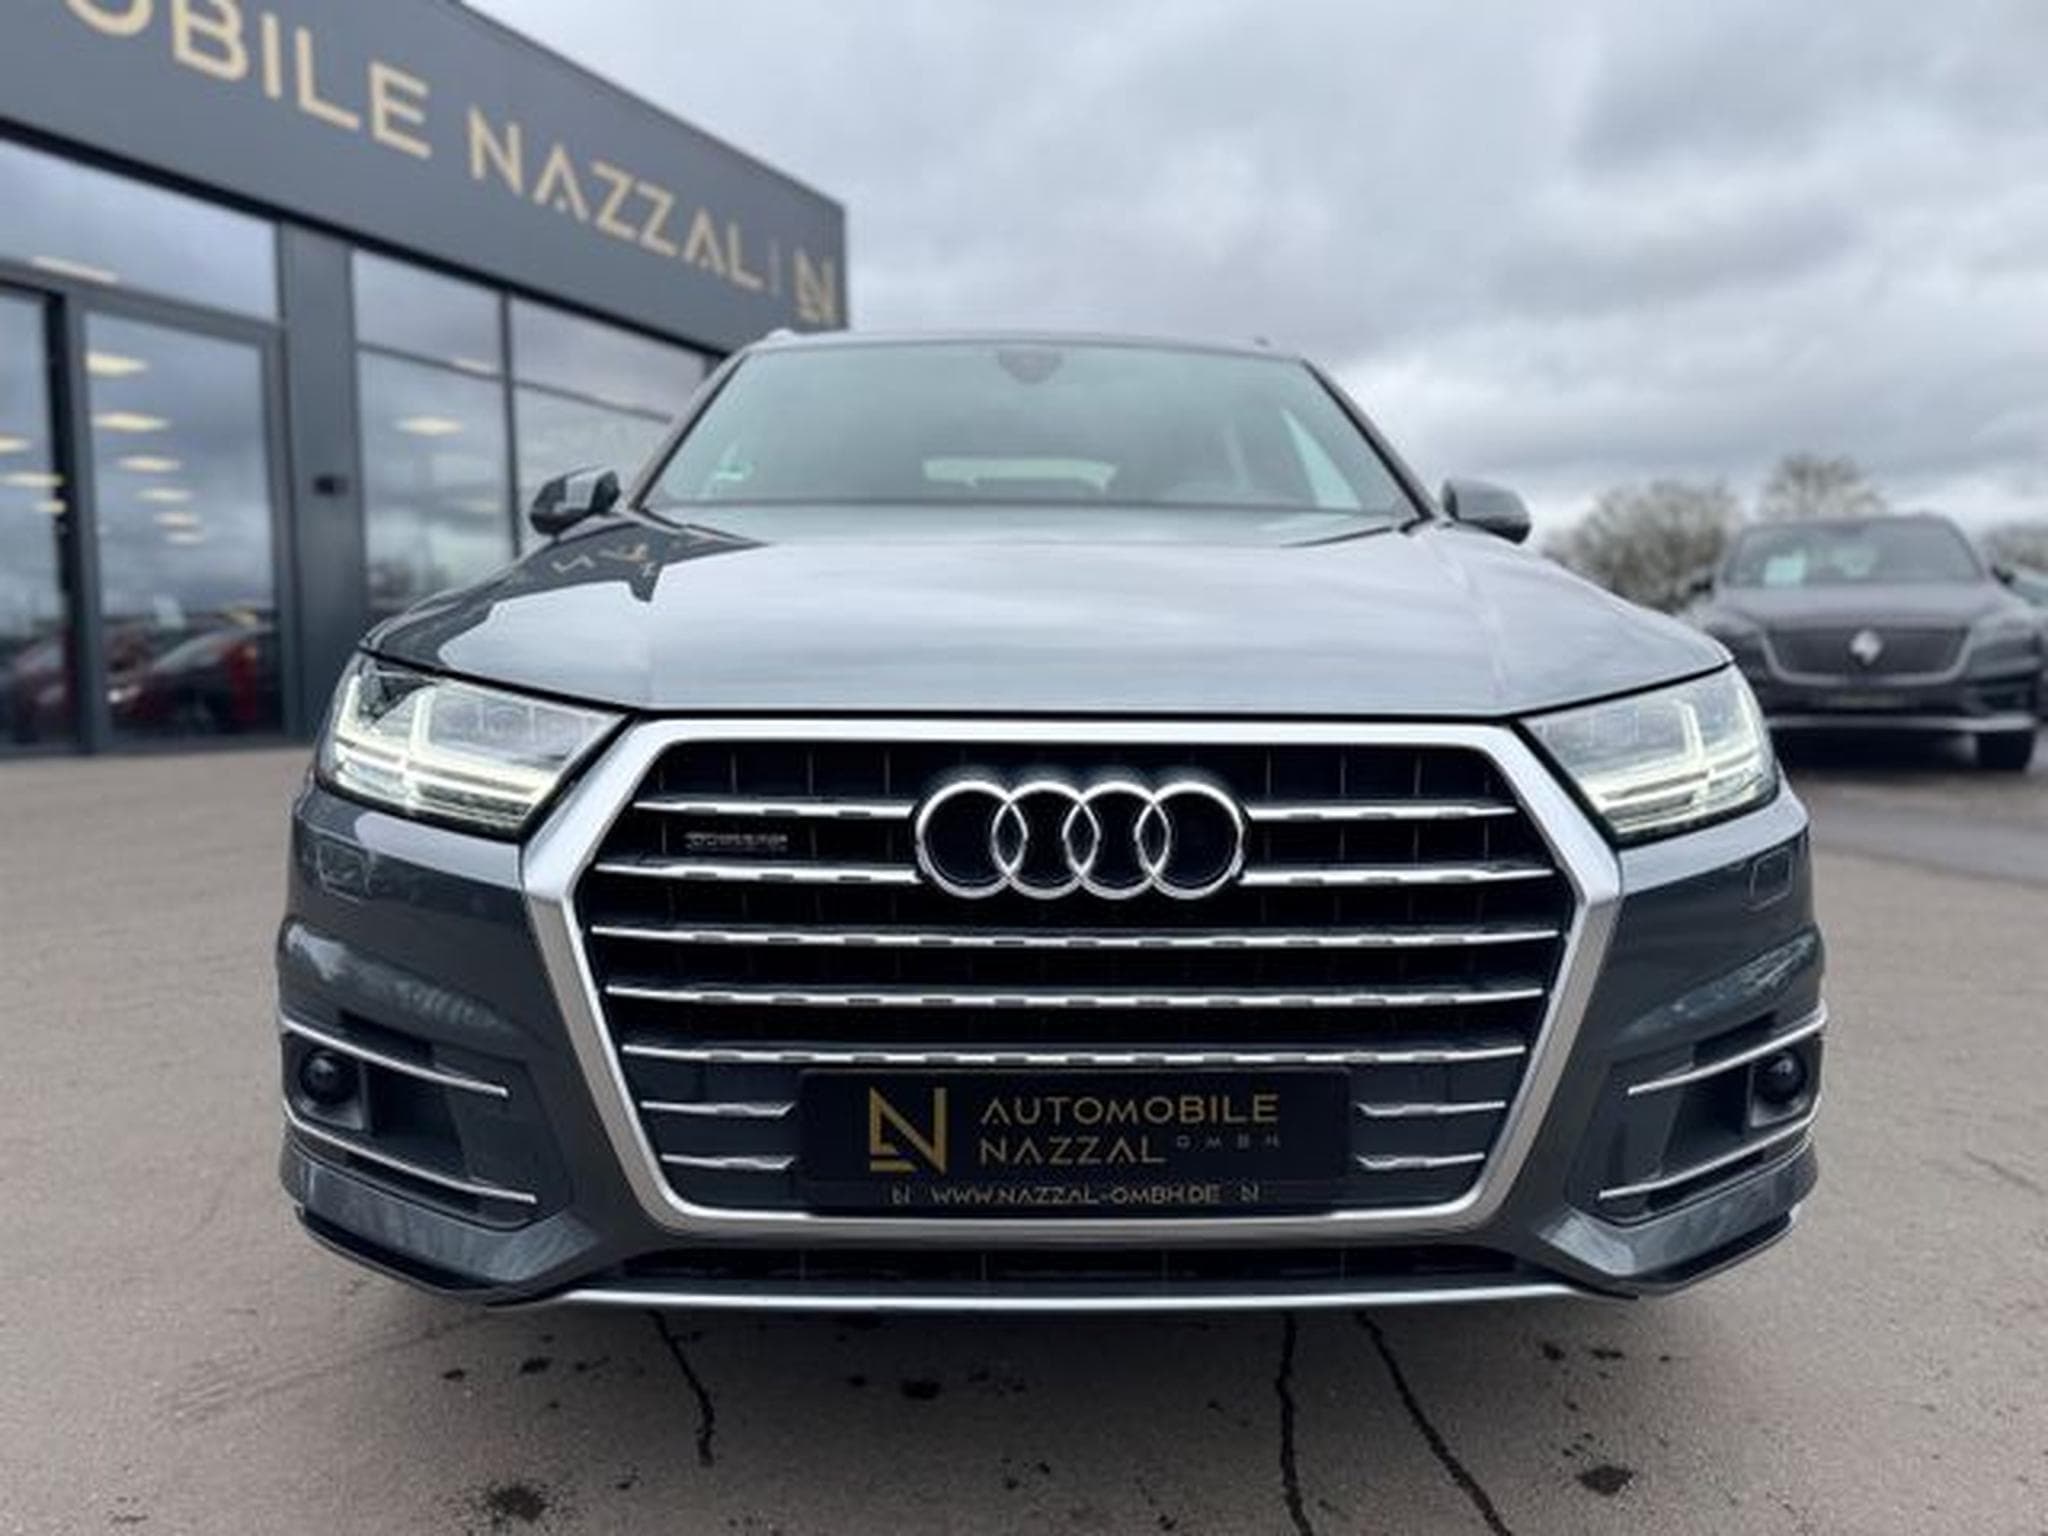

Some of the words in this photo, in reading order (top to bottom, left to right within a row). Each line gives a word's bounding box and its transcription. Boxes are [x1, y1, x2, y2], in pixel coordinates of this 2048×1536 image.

[468, 104, 764, 292] NAZZAL
[980, 1094, 1280, 1126] AUTOMOBILE
[980, 1136, 1167, 1165] NAZZAL
